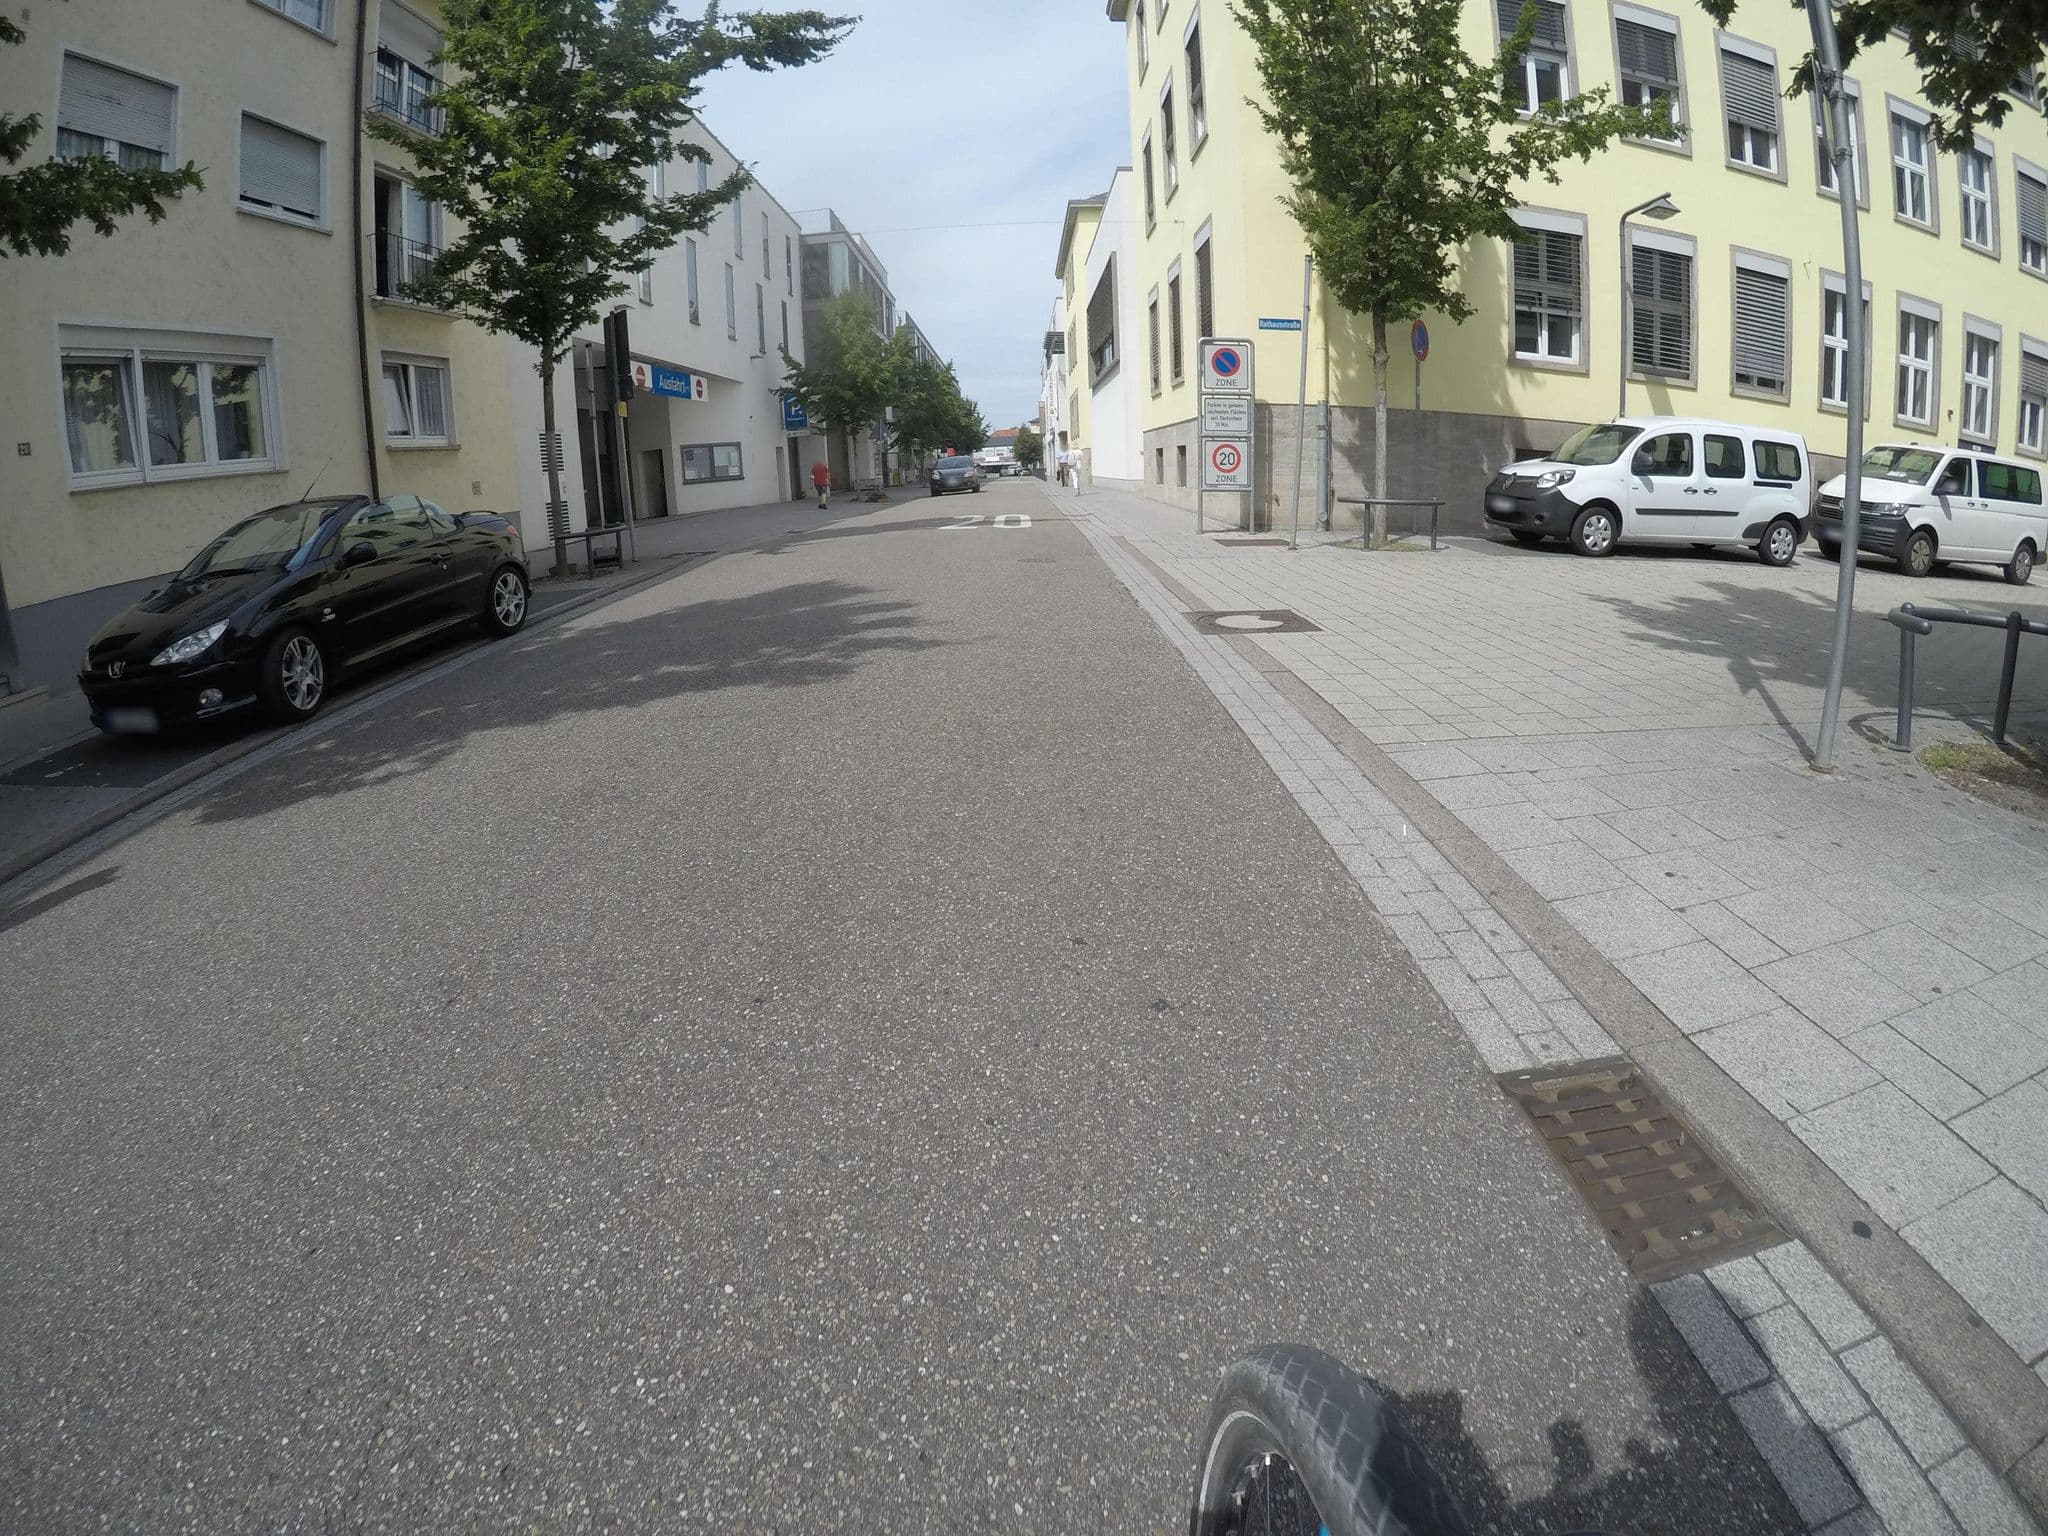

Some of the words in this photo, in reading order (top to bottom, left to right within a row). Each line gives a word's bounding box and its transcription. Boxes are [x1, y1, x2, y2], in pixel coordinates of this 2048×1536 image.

[659, 373, 687, 394] Ausfahrt
[1215, 379, 1238, 387] ZONE
[1219, 452, 1236, 466] 20
[1215, 475, 1238, 483] ZONE
[938, 514, 1033, 530] 20
